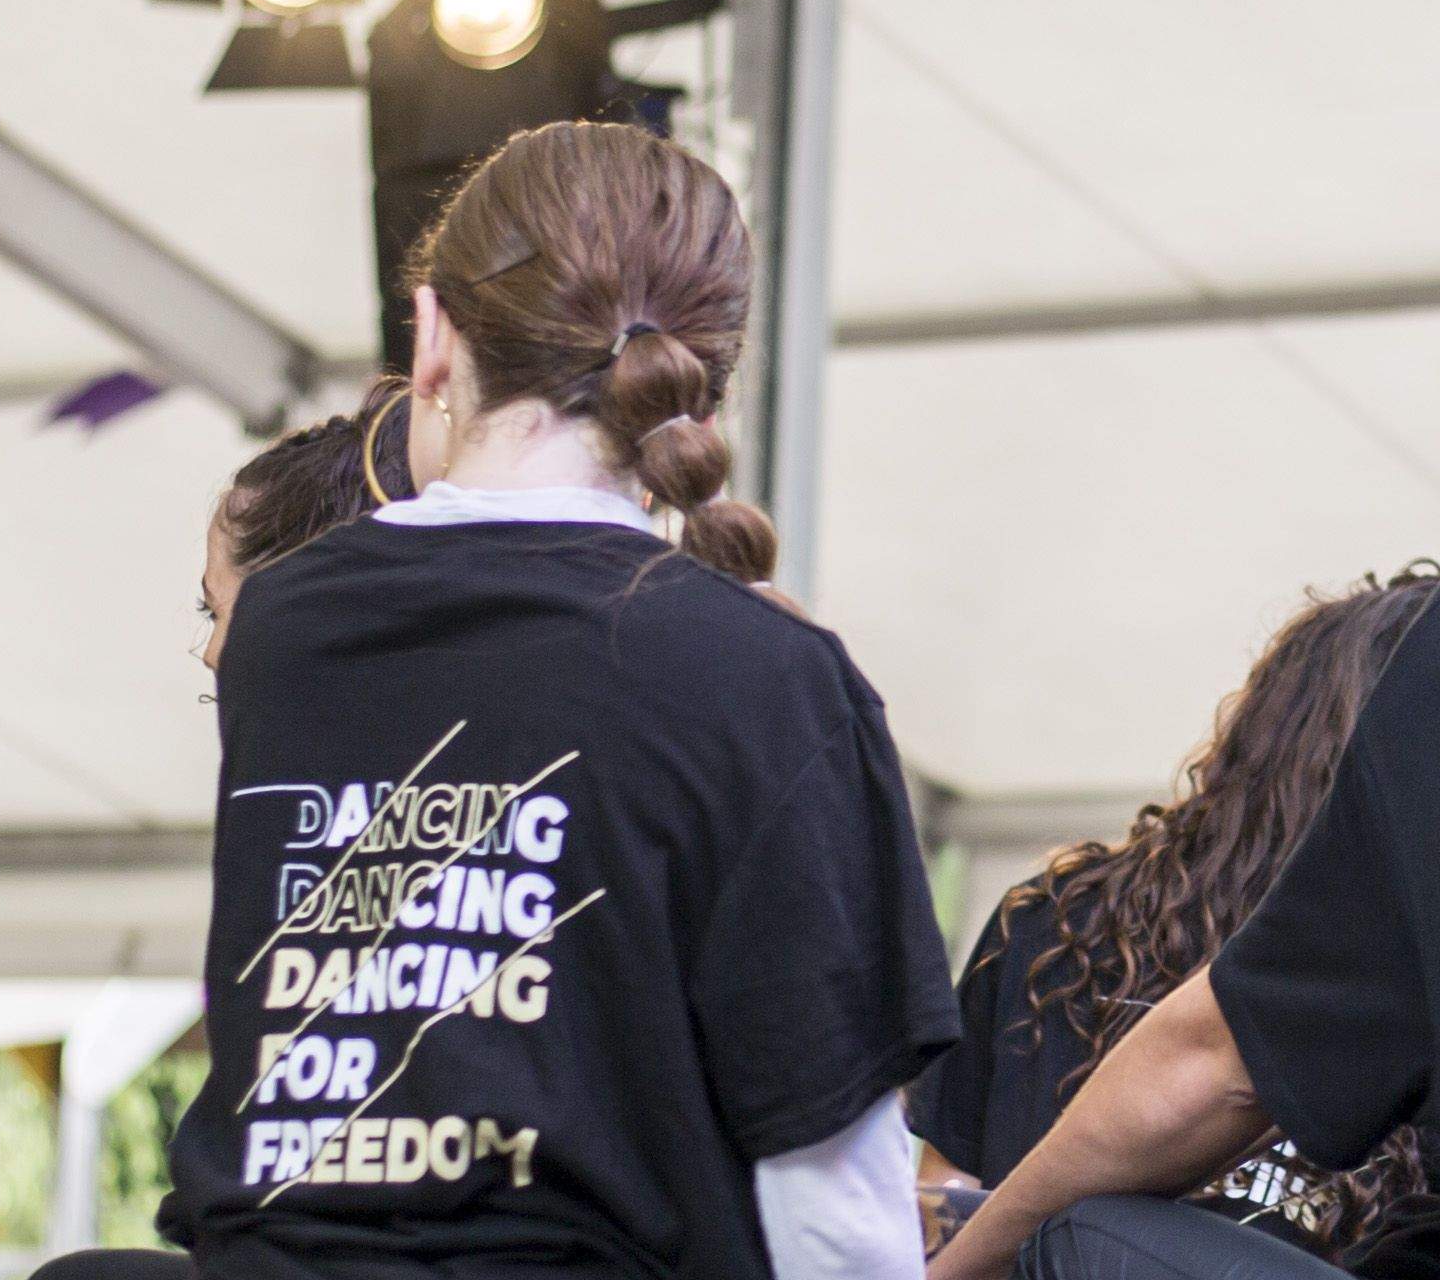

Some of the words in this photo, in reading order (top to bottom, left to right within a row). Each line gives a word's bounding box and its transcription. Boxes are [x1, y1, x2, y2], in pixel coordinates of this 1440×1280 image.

[284, 783, 570, 863] DANCING
[277, 863, 556, 939] DANCING
[264, 943, 554, 1023] DANCING
[257, 1033, 377, 1103] FOR
[243, 1116, 539, 1188] FREEDOM
